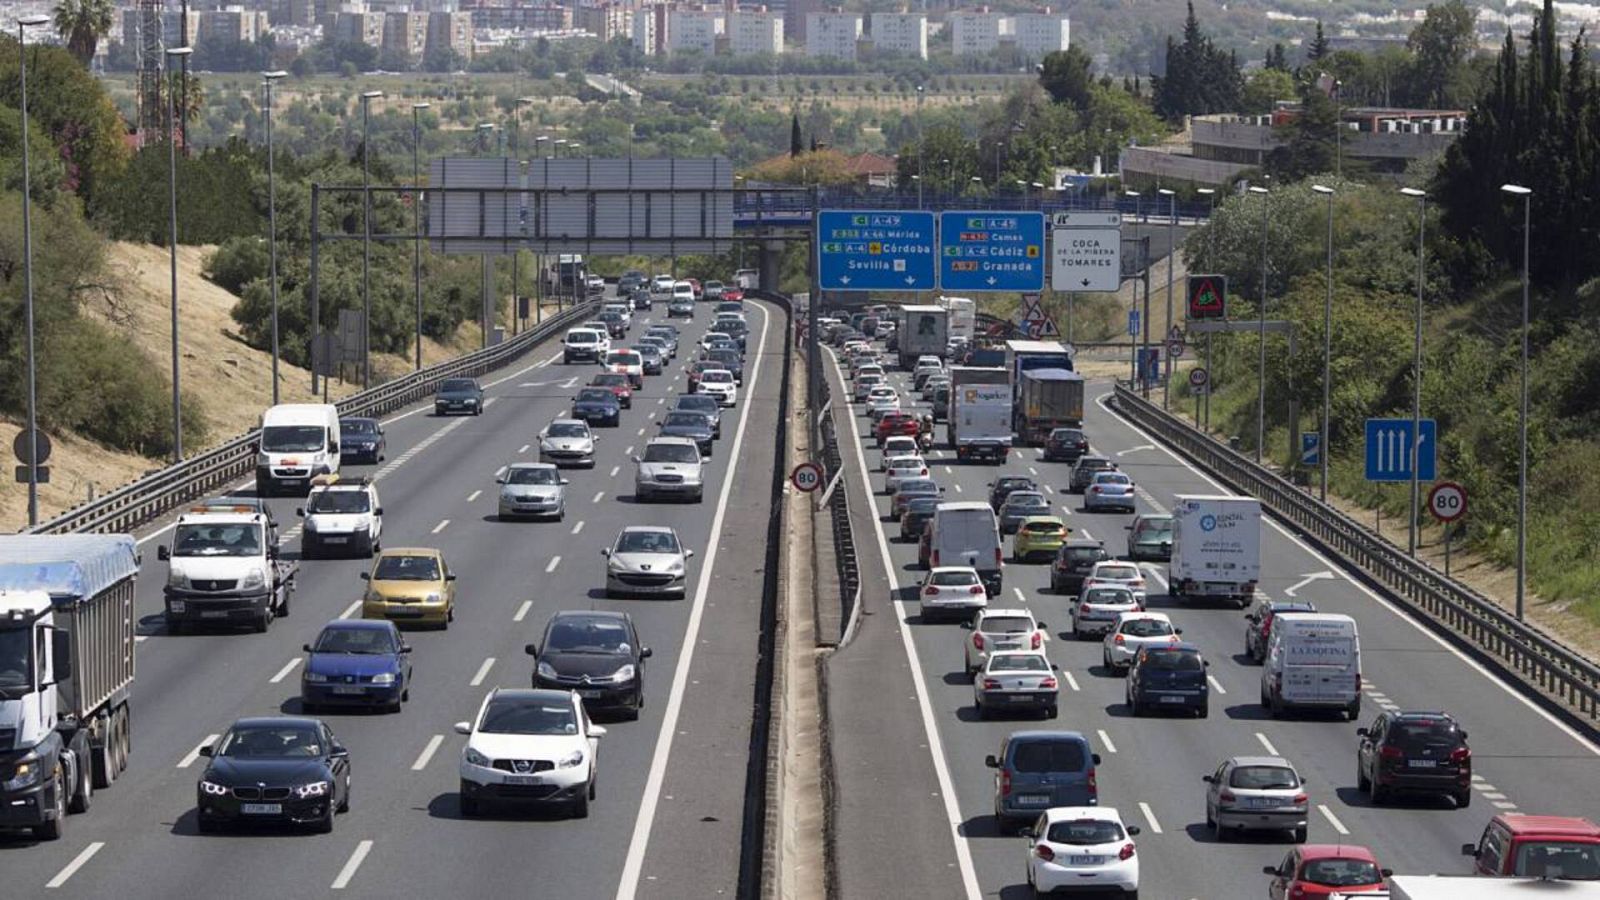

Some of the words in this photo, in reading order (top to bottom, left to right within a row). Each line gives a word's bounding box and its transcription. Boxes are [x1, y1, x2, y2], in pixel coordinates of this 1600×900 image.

[883, 243, 930, 254] Córdoba
[1072, 239, 1100, 248] COCA
[990, 246, 1023, 256] Cádiz
[848, 260, 890, 269] Sevilla
[983, 262, 1032, 271] Granada
[1062, 258, 1111, 266] TOMARES
[799, 472, 816, 483] 80
[1436, 495, 1460, 509] 80
[1291, 647, 1304, 655] LA
[1305, 647, 1347, 657] ESQUINA
